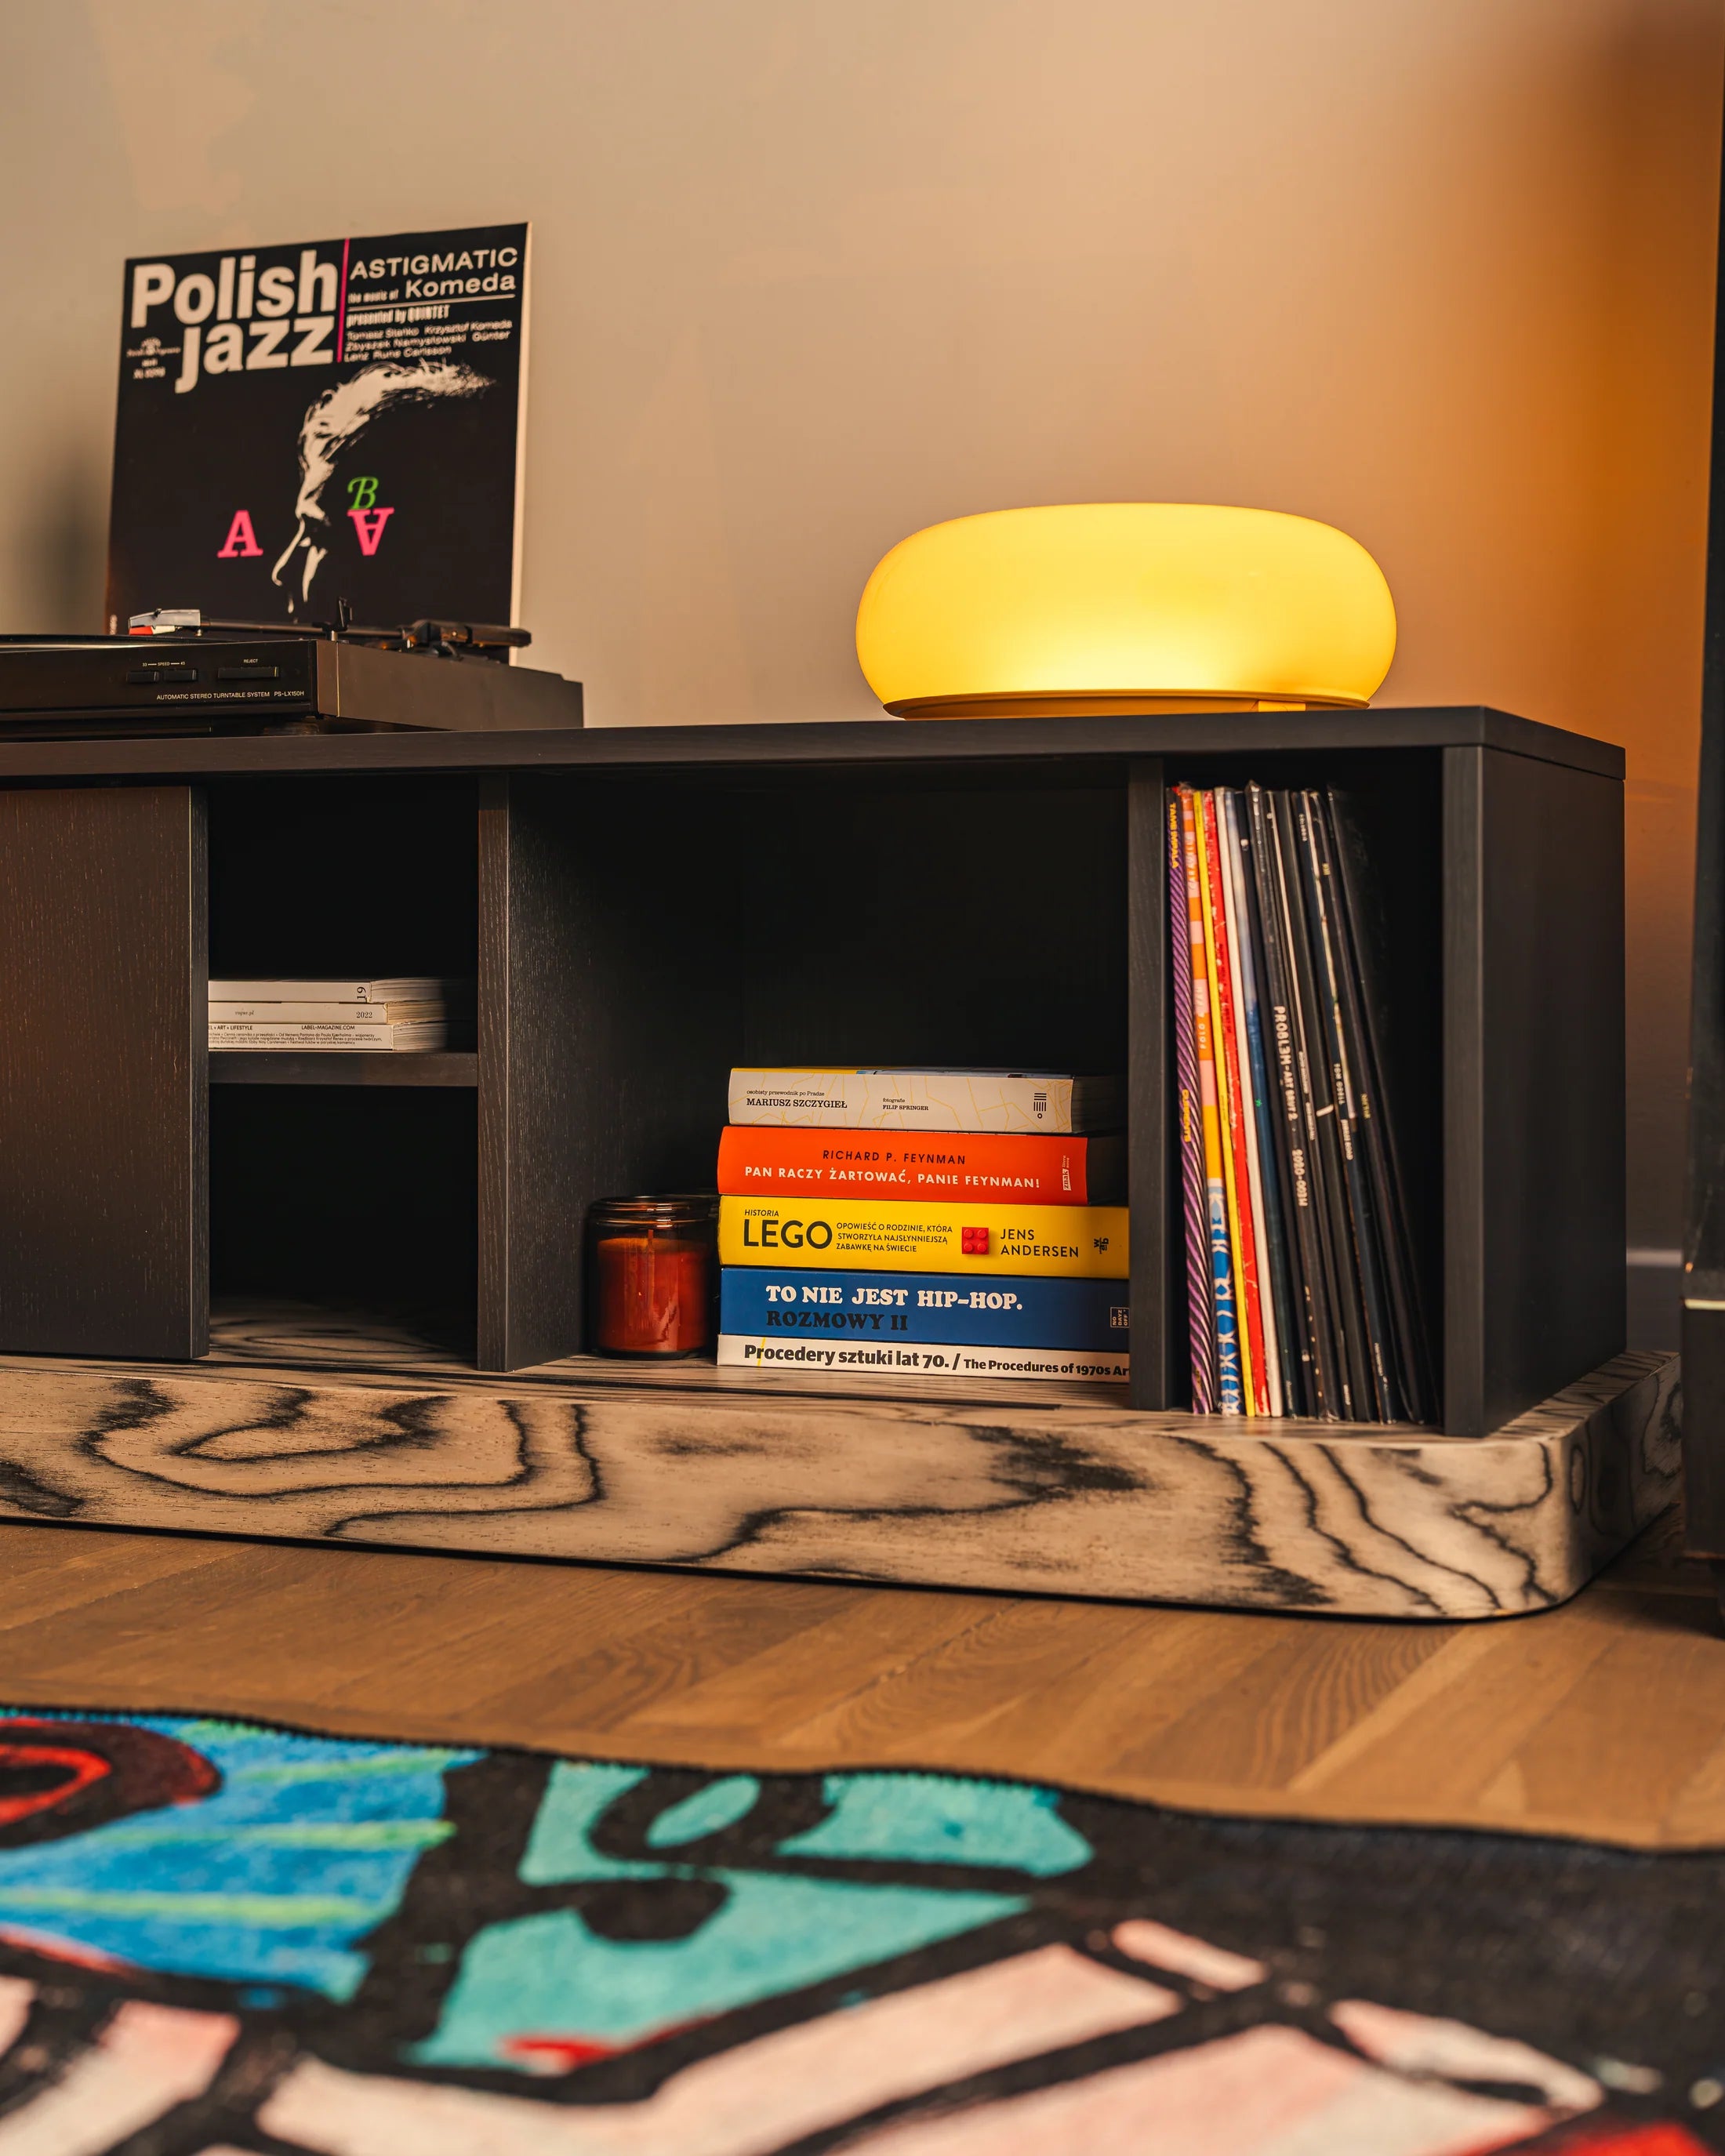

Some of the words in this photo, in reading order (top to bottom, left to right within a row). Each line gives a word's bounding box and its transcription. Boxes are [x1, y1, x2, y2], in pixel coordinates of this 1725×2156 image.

[350, 246, 518, 281] ASTIGMATIC
[131, 249, 339, 328] Polish
[405, 272, 517, 299] Komeda
[174, 315, 336, 394] jazz
[347, 476, 379, 510] B
[216, 510, 263, 558] A
[1169, 803, 1178, 832] TAME
[1171, 833, 1179, 869] IMPALA
[357, 986, 366, 1000] 19
[746, 1098, 791, 1107] MARIUSZ
[793, 1099, 848, 1109] SZCZYGIEŁ
[1182, 1089, 1192, 1142] CURRENTS
[823, 1149, 880, 1161] RICHARD
[886, 1152, 897, 1162] P.
[903, 1152, 966, 1165] FEYNMAN
[745, 1166, 772, 1177] PAN
[779, 1167, 823, 1179] RACZY
[829, 1167, 911, 1185] ŻARTOWAĆ,
[917, 1174, 958, 1185] PANIE
[965, 1175, 1040, 1189] FEYNMAN!
[1062, 1169, 1071, 1190] znak
[743, 1218, 833, 1250] LEGO
[837, 1221, 877, 1231] OPOWIEŚĆ
[886, 1223, 925, 1233] RODZINIE,
[927, 1223, 953, 1233] KTÓRA
[1000, 1229, 1035, 1240] JENS
[836, 1243, 873, 1253] ZABAWKĘ
[886, 1243, 917, 1252] ŚWIECIE
[1000, 1244, 1079, 1258] ANDERSEN
[765, 1285, 797, 1303] TO
[801, 1286, 843, 1305] NIE
[851, 1287, 909, 1306] JEST
[917, 1290, 1023, 1311] HIP-HOP.
[766, 1310, 885, 1331] ROZMOWY
[890, 1314, 908, 1331] II
[1113, 1316, 1117, 1326] NO
[744, 1344, 836, 1367] Procedery
[838, 1349, 893, 1366] sztuki
[895, 1350, 919, 1367] lat
[922, 1355, 950, 1369] 70.
[952, 1353, 961, 1370] /
[964, 1359, 986, 1370] The
[989, 1359, 1059, 1374] Procedures
[1061, 1363, 1074, 1374] of
[1076, 1365, 1111, 1376] 1970s
[1113, 1365, 1130, 1376] Ar
